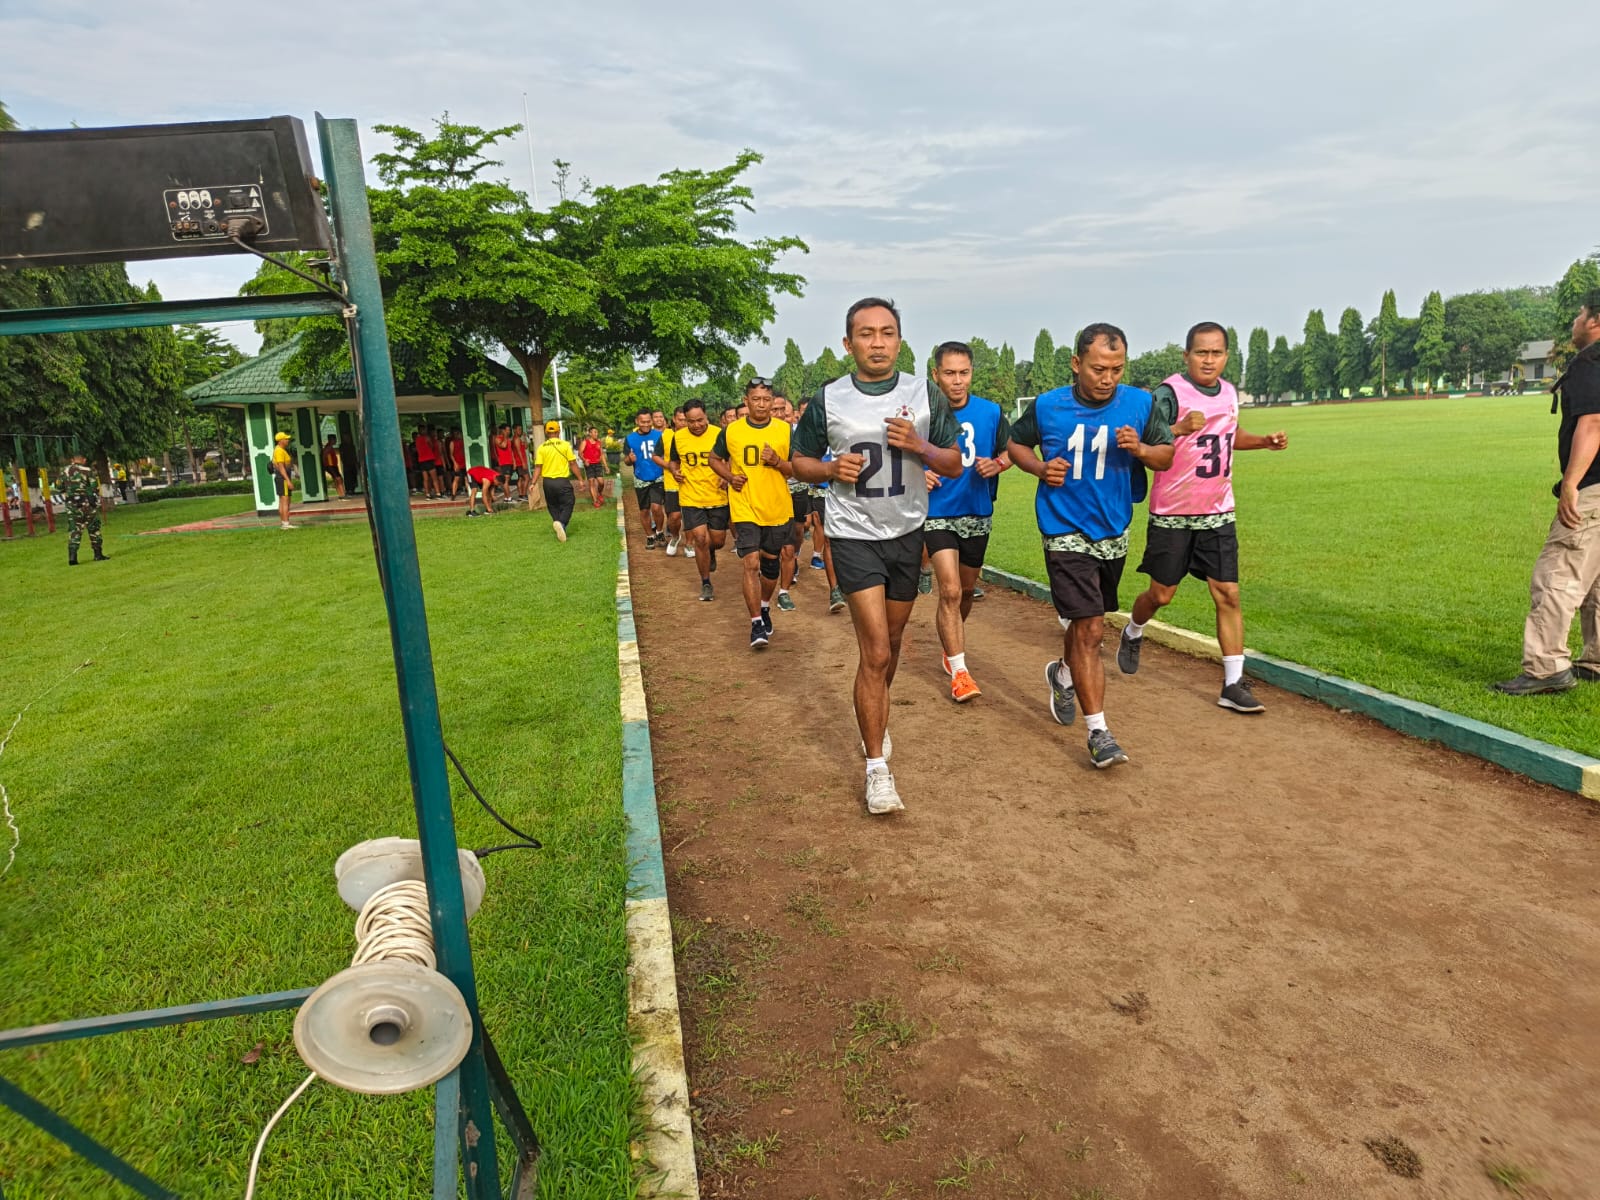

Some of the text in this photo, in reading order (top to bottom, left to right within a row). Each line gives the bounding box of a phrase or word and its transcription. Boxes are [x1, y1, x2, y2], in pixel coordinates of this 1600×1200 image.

[640, 440, 655, 459] 15
[849, 441, 905, 498] 21
[1067, 423, 1109, 480] 11
[1196, 433, 1234, 479] 31
